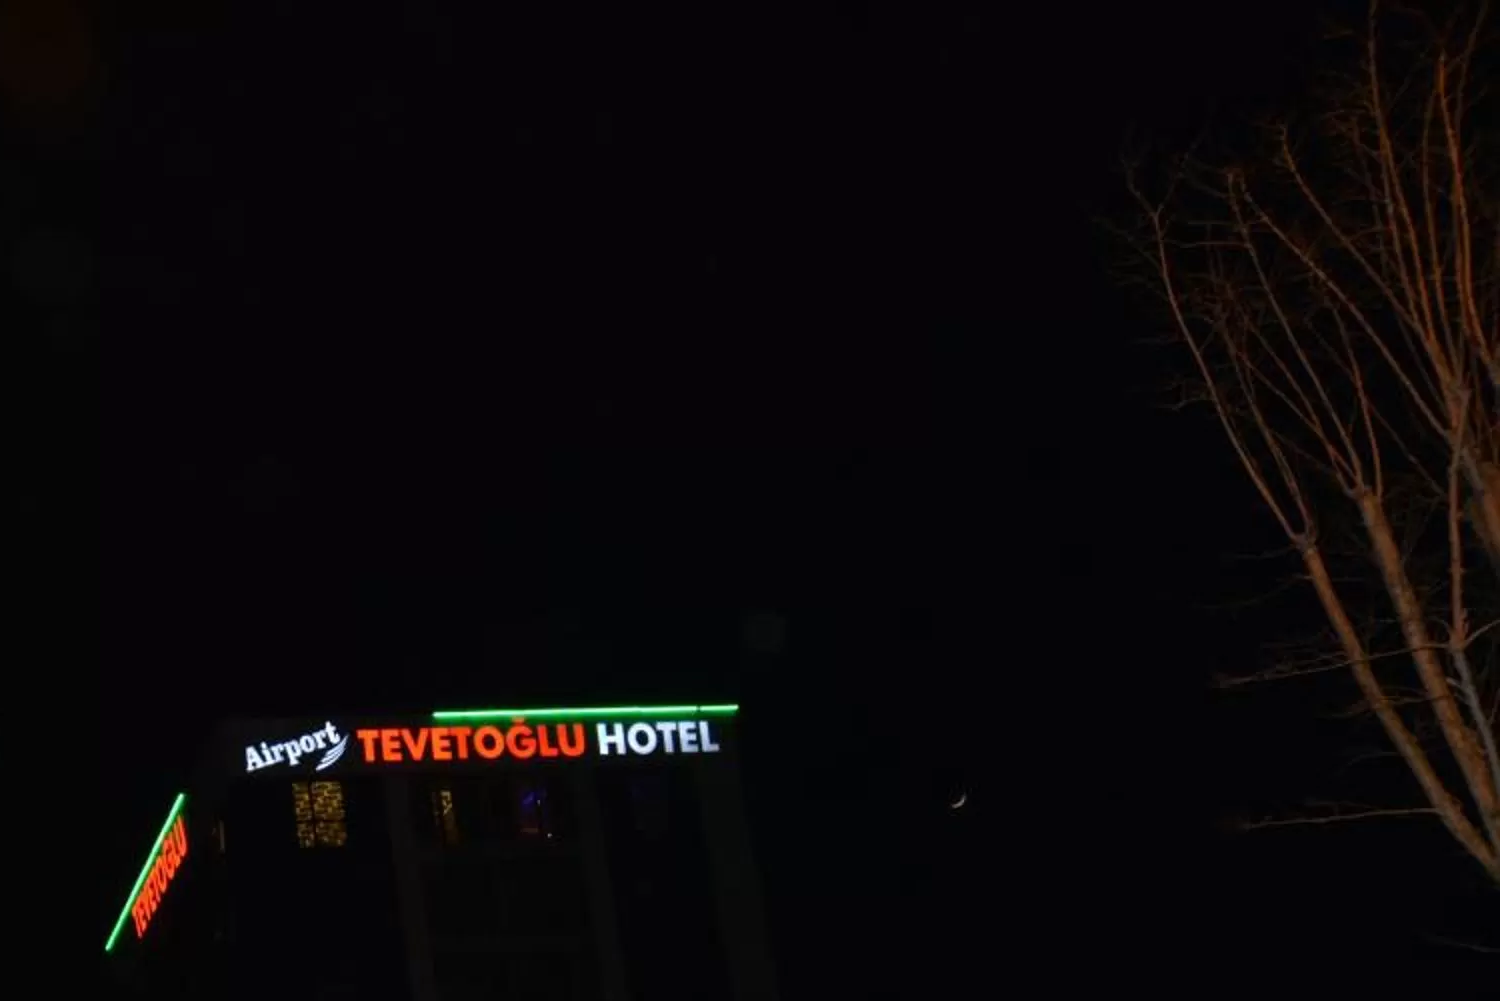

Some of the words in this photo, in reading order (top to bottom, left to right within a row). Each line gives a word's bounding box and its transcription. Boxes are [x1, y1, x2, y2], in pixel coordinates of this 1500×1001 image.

[245, 720, 341, 772] Airport
[356, 716, 586, 763] TEVETOĞLU
[596, 720, 720, 756] HOTEL
